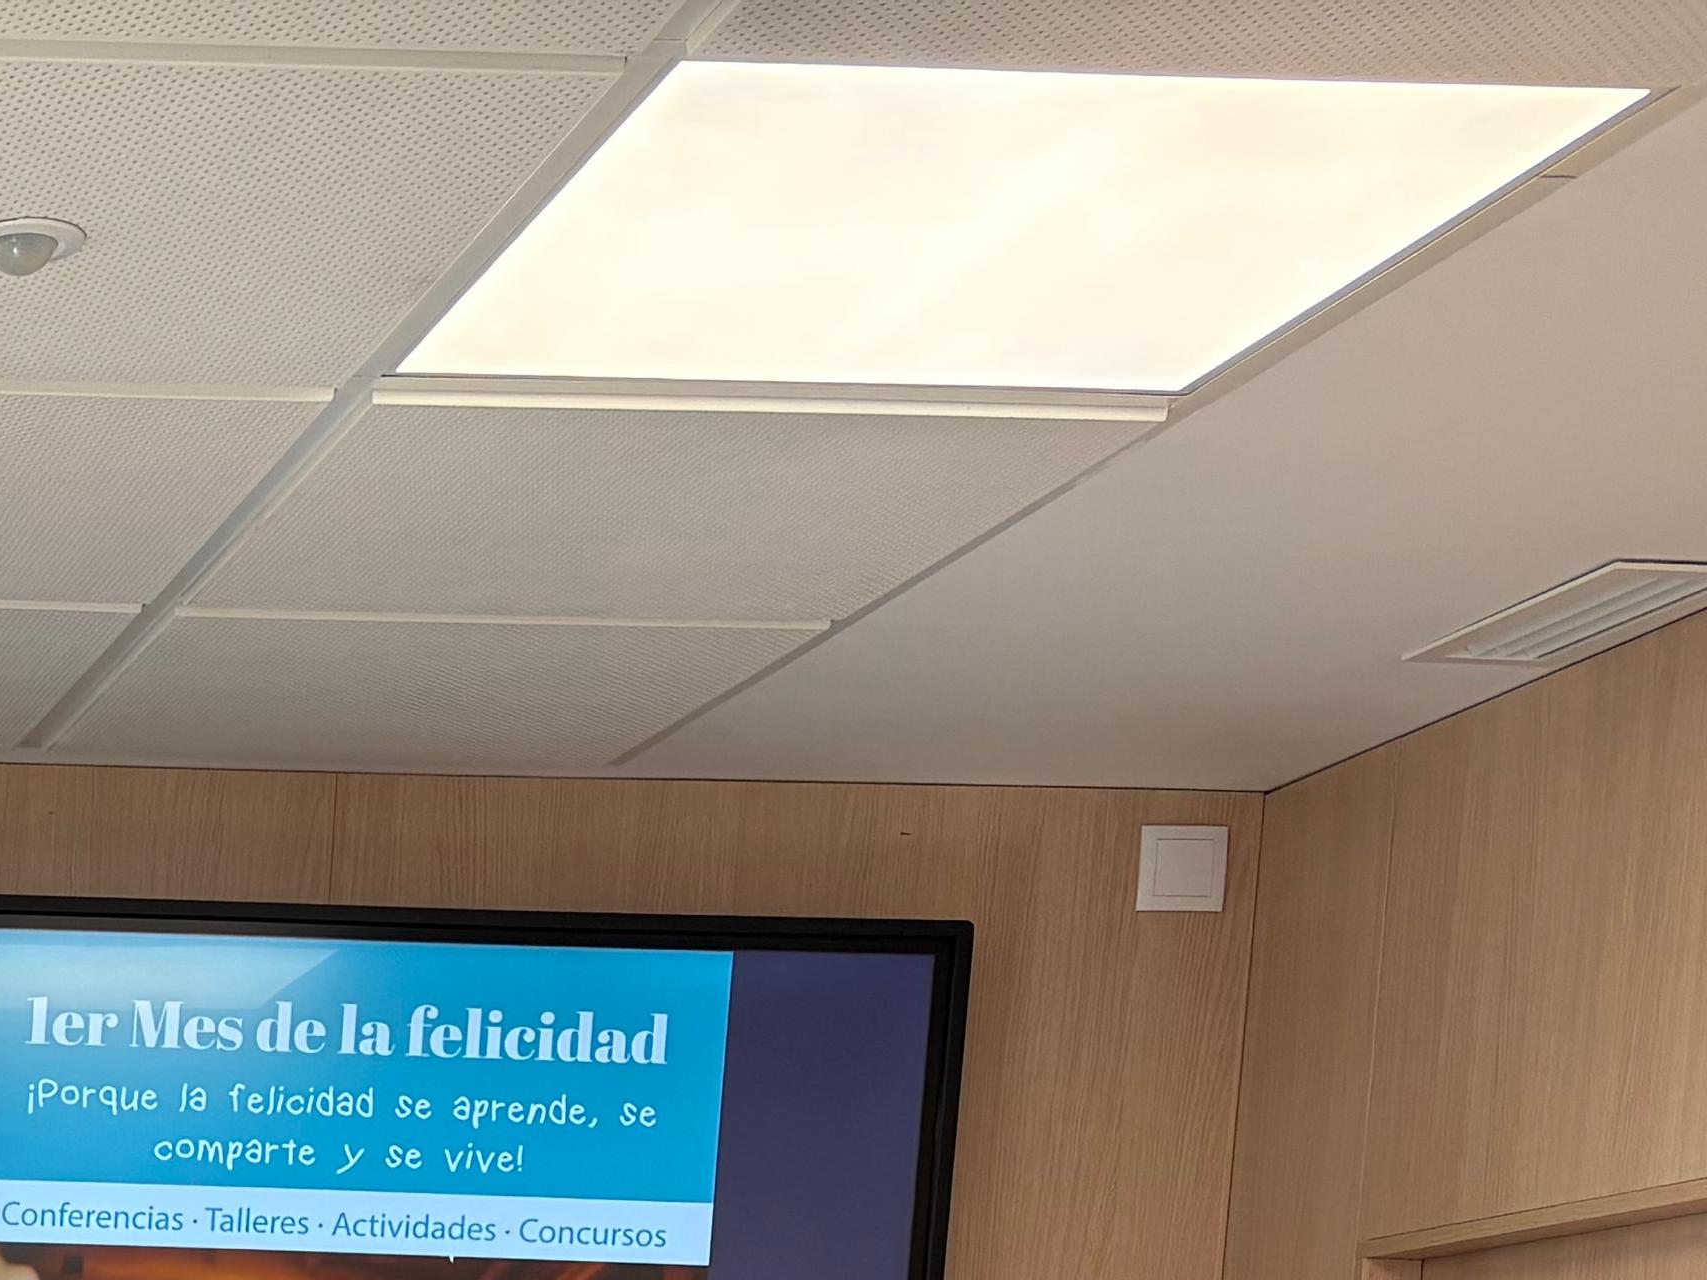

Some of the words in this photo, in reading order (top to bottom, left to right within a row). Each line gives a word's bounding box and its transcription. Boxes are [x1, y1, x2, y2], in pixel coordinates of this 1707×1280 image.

[25, 996, 118, 1046] 1er
[129, 999, 243, 1051] Mes
[256, 1001, 327, 1054] de
[337, 1003, 395, 1056] la
[404, 1005, 668, 1065] felicidad
[27, 1078, 158, 1116] ¡Porque
[179, 1083, 207, 1112] la
[228, 1083, 374, 1118] felicidad
[394, 1095, 432, 1120] se
[452, 1093, 598, 1130] aprende,
[619, 1102, 657, 1127] se
[154, 1138, 316, 1171] comparte
[336, 1143, 365, 1175] y
[385, 1145, 422, 1170] se
[444, 1142, 523, 1174] vive!
[1, 1201, 184, 1231] Conferencias
[204, 1206, 309, 1235] Talleres
[331, 1212, 496, 1242] Actividades
[519, 1218, 667, 1248] Concursos
